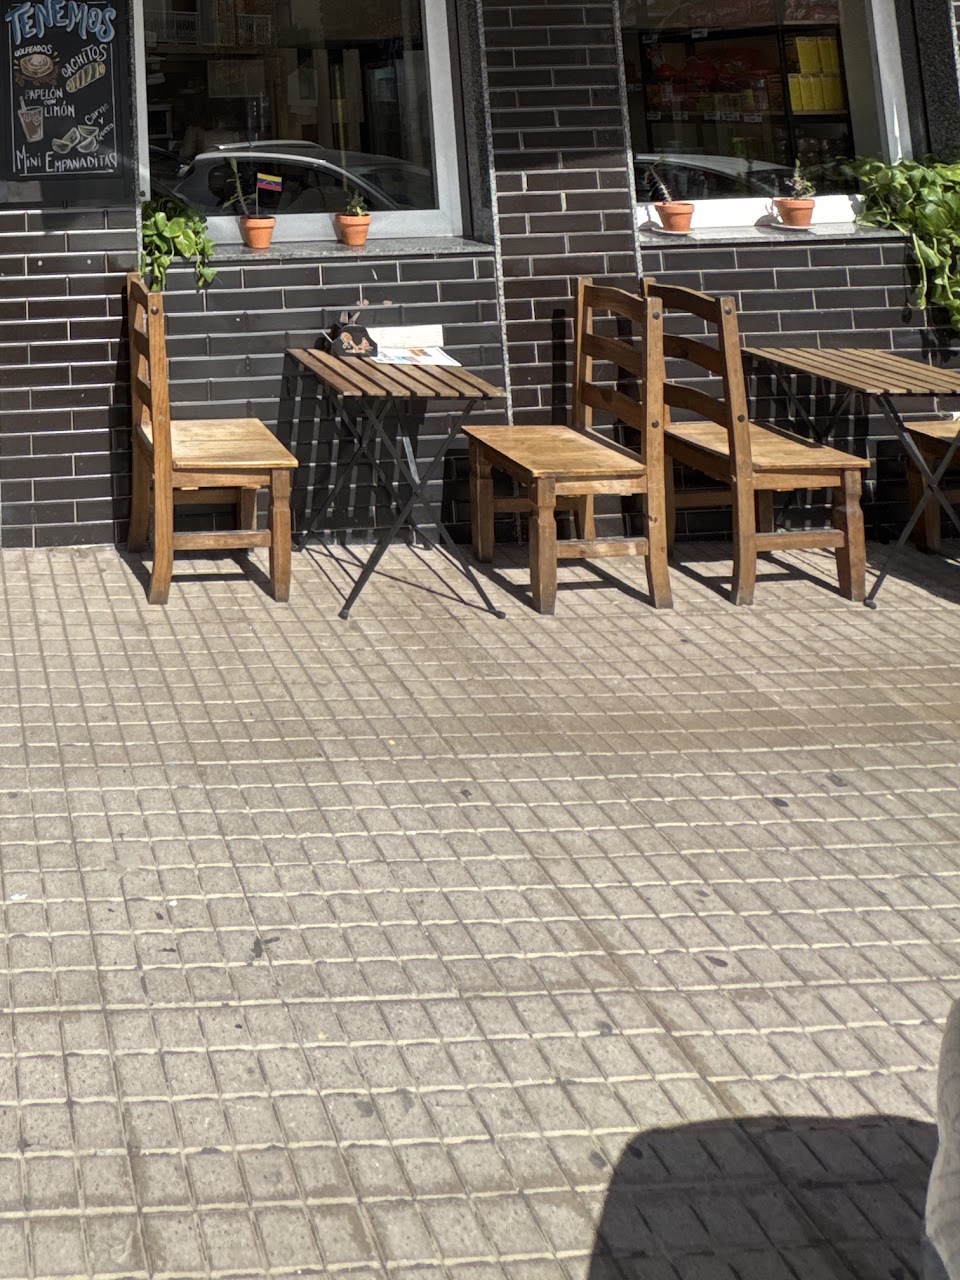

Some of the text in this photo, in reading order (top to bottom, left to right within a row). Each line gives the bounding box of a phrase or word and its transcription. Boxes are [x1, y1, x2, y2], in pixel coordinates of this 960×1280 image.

[14, 44, 53, 57] GOLFEADOS
[61, 44, 108, 78] CACHITOS
[25, 86, 64, 100] PAPELÓN
[44, 100, 75, 118] LIMÓN
[84, 103, 110, 125] Carne
